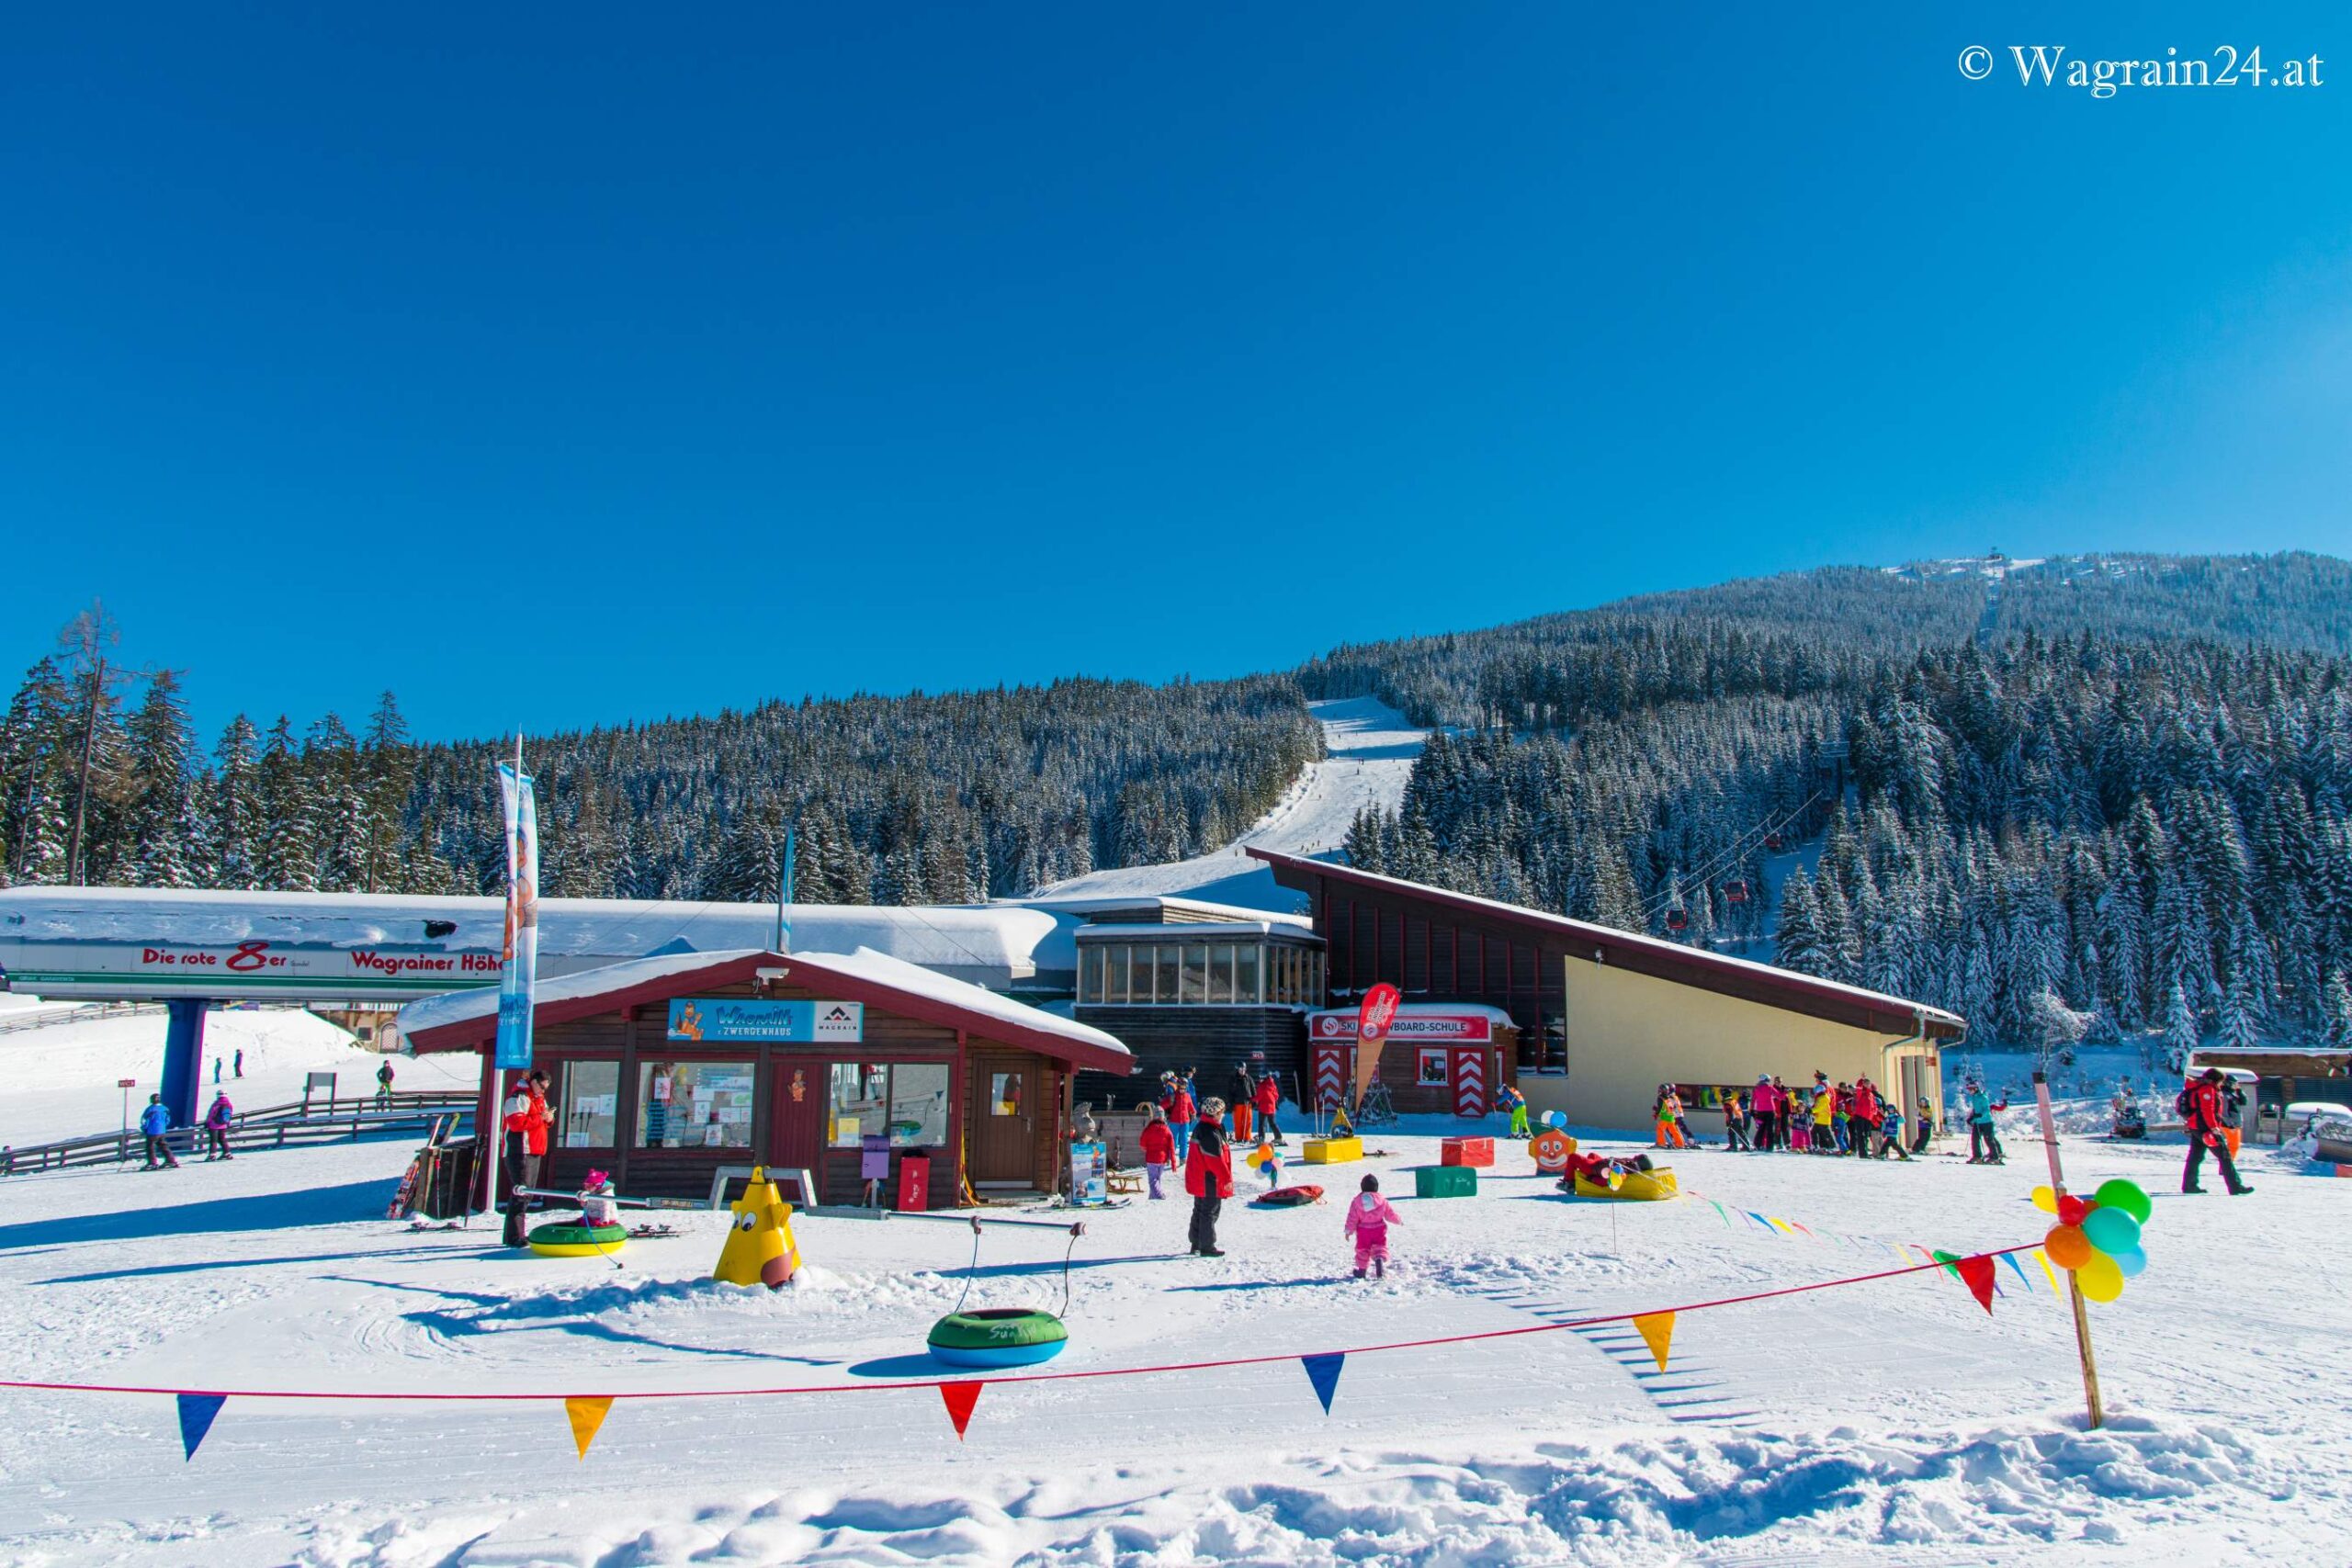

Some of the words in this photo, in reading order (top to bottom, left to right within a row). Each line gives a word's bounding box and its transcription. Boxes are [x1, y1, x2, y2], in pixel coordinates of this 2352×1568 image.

[142, 948, 175, 964] Die
[181, 952, 217, 965] rote
[351, 951, 454, 975] Wagrainer
[723, 1027, 791, 1036] ZWERGENHAUS
[1340, 1021, 1356, 1031] SKI
[1388, 1021, 1467, 1032] BOARD-SCHULE
